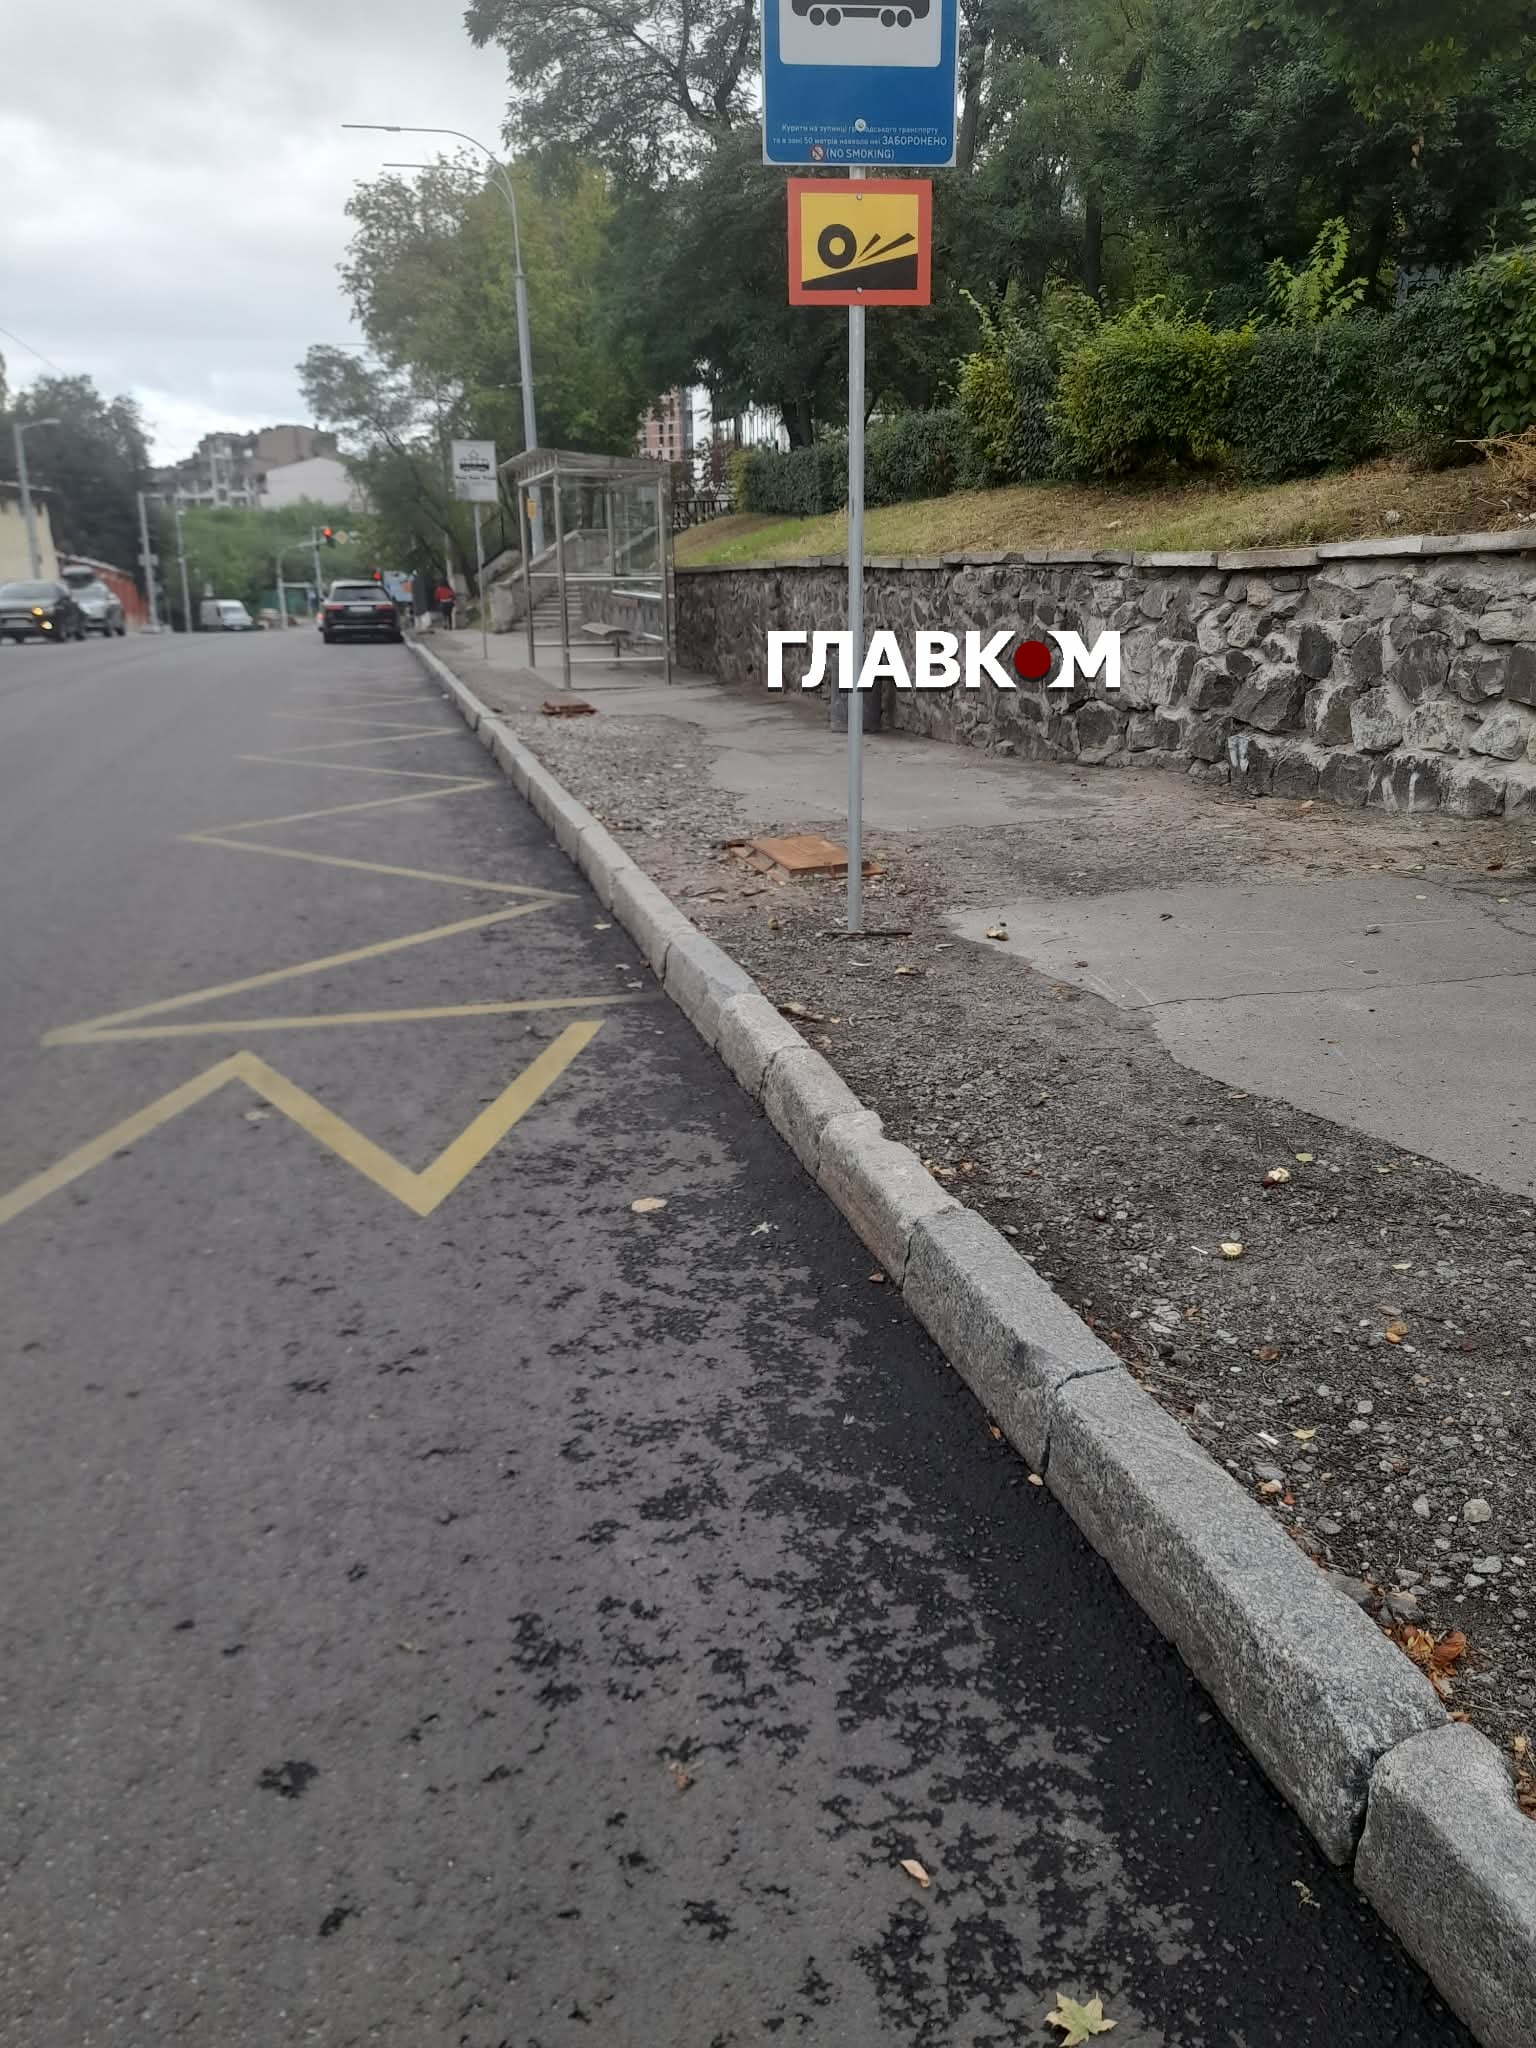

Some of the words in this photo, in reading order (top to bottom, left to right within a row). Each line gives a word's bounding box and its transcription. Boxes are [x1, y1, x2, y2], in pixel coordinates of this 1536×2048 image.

[782, 124, 808, 134] Курити
[849, 126, 897, 134] градського
[899, 127, 938, 135] транспорту
[804, 136, 813, 144] 50
[882, 135, 947, 146] ЗАБОРОНЕНО
[826, 148, 844, 159] (NO
[846, 148, 895, 159] SMOKING)
